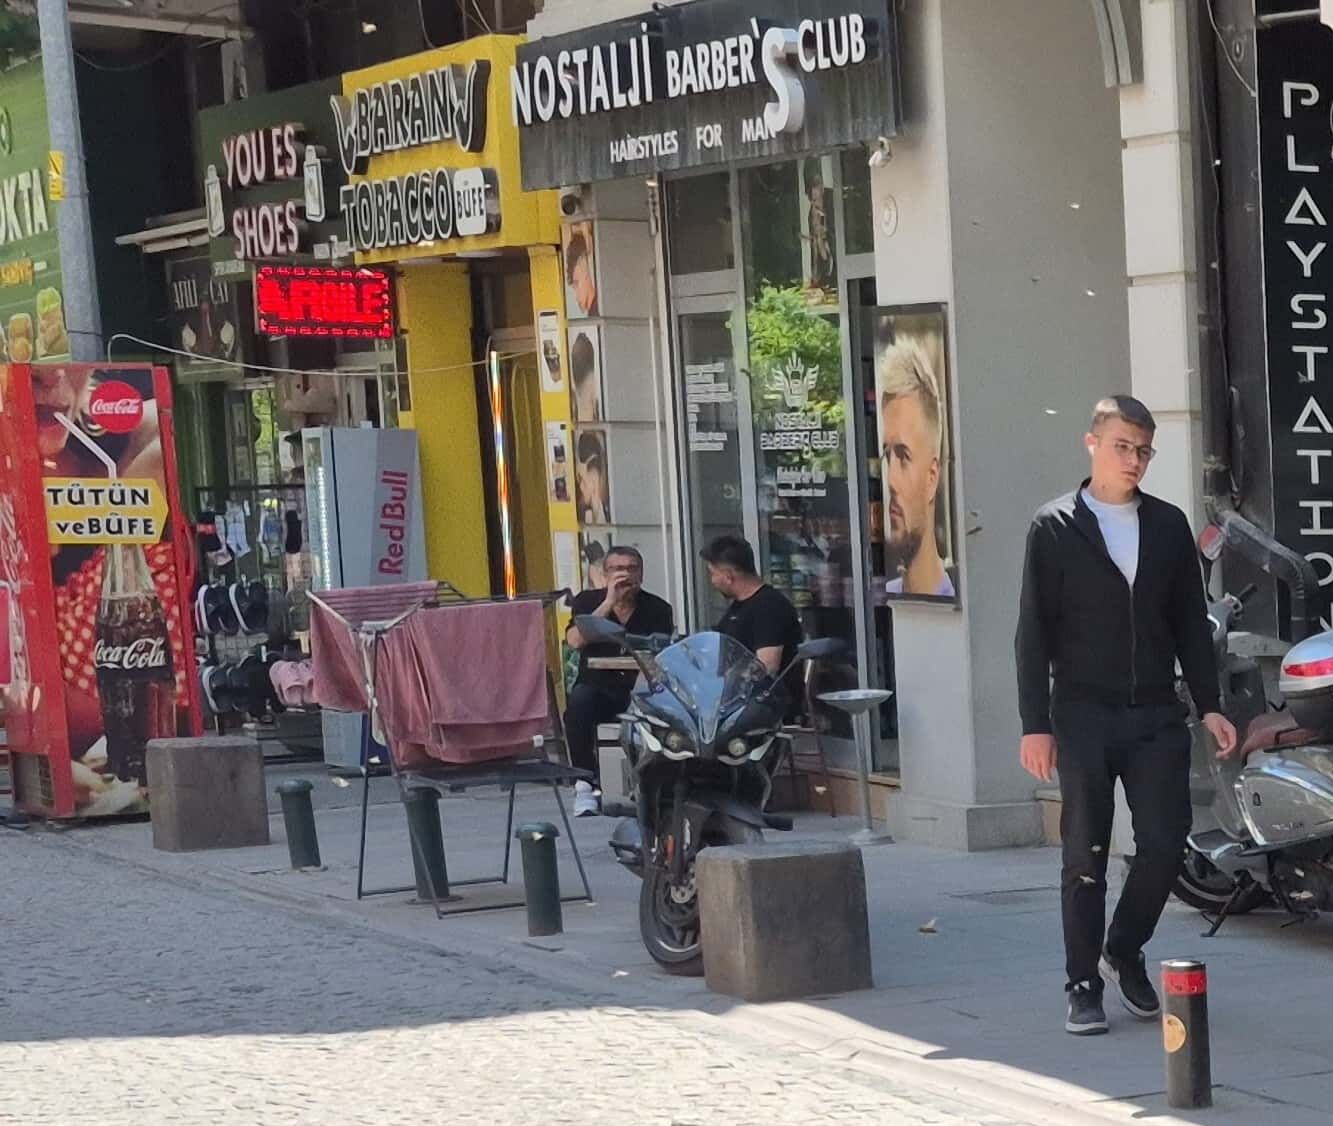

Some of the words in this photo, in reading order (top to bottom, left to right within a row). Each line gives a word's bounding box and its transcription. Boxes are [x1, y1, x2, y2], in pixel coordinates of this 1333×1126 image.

[799, 14, 866, 74] CLUB
[354, 66, 453, 157] BARAN
[696, 123, 722, 151] FOR
[742, 117, 776, 143] MAN
[222, 133, 266, 188] YOU
[272, 125, 298, 178] ES
[0, 168, 49, 245] KTA
[232, 201, 299, 259] SHOES
[340, 167, 453, 252] TOBACCO
[456, 184, 485, 219] BÜFE
[47, 484, 150, 506] TÜTÜN
[381, 470, 409, 519] Bull
[379, 524, 406, 576] Red
